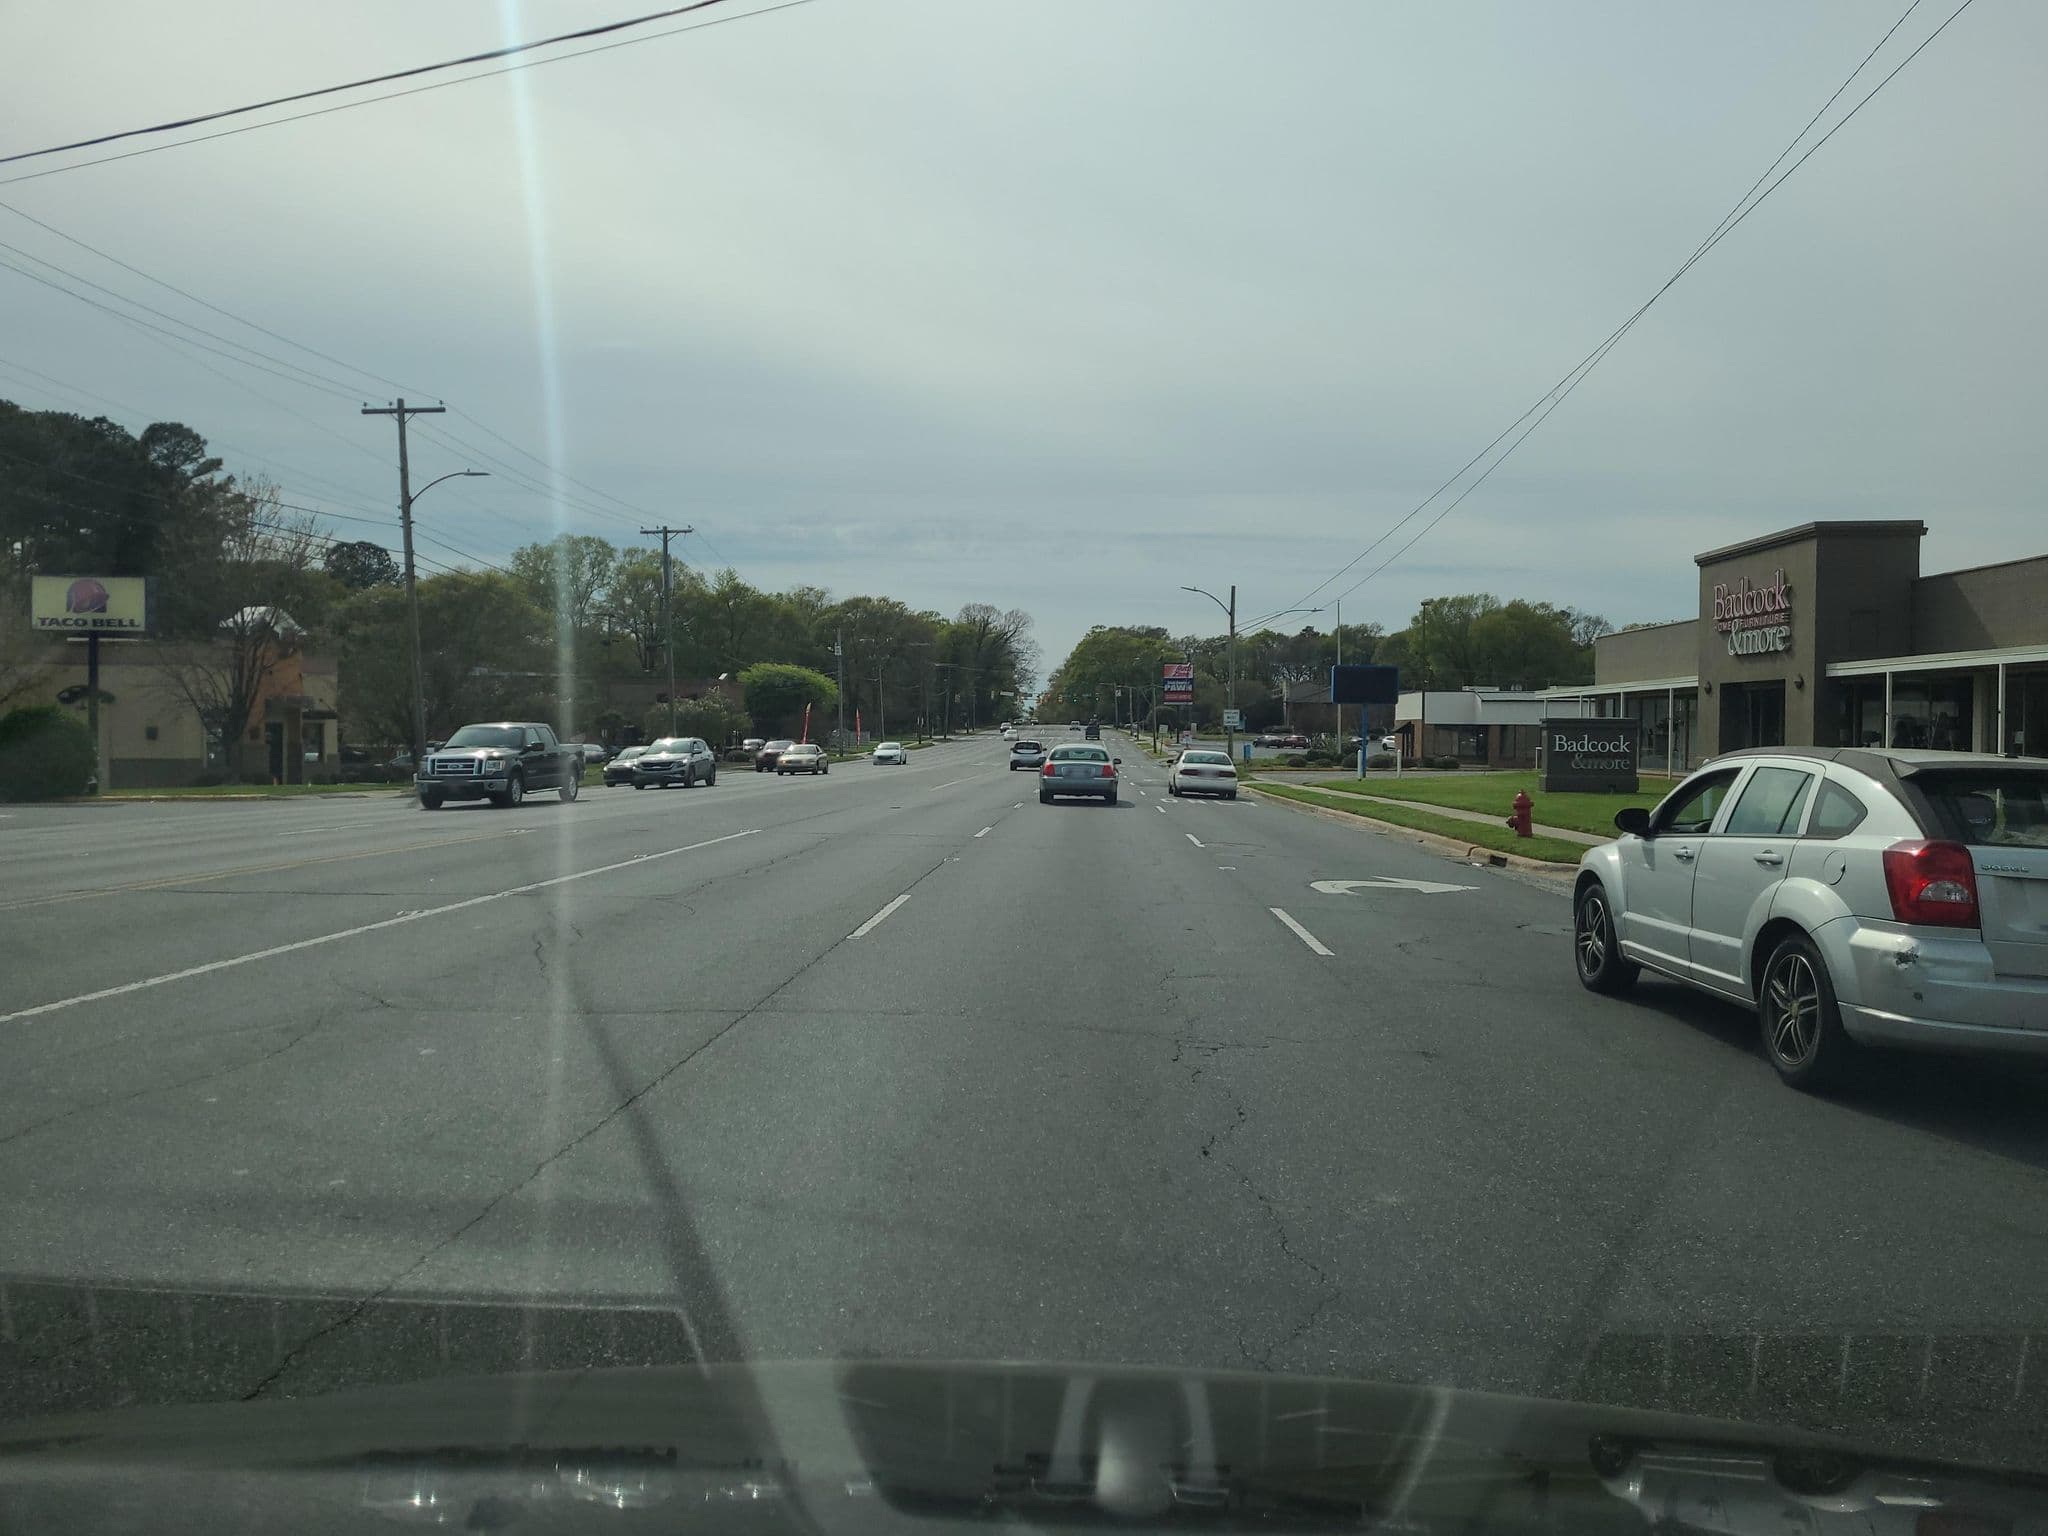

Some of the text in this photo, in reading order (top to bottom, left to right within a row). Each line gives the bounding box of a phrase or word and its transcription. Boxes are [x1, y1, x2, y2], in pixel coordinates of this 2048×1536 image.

[1713, 569, 1787, 620] Badcock
[38, 617, 141, 628] TACO BELL
[1553, 734, 1631, 753] Badcock
